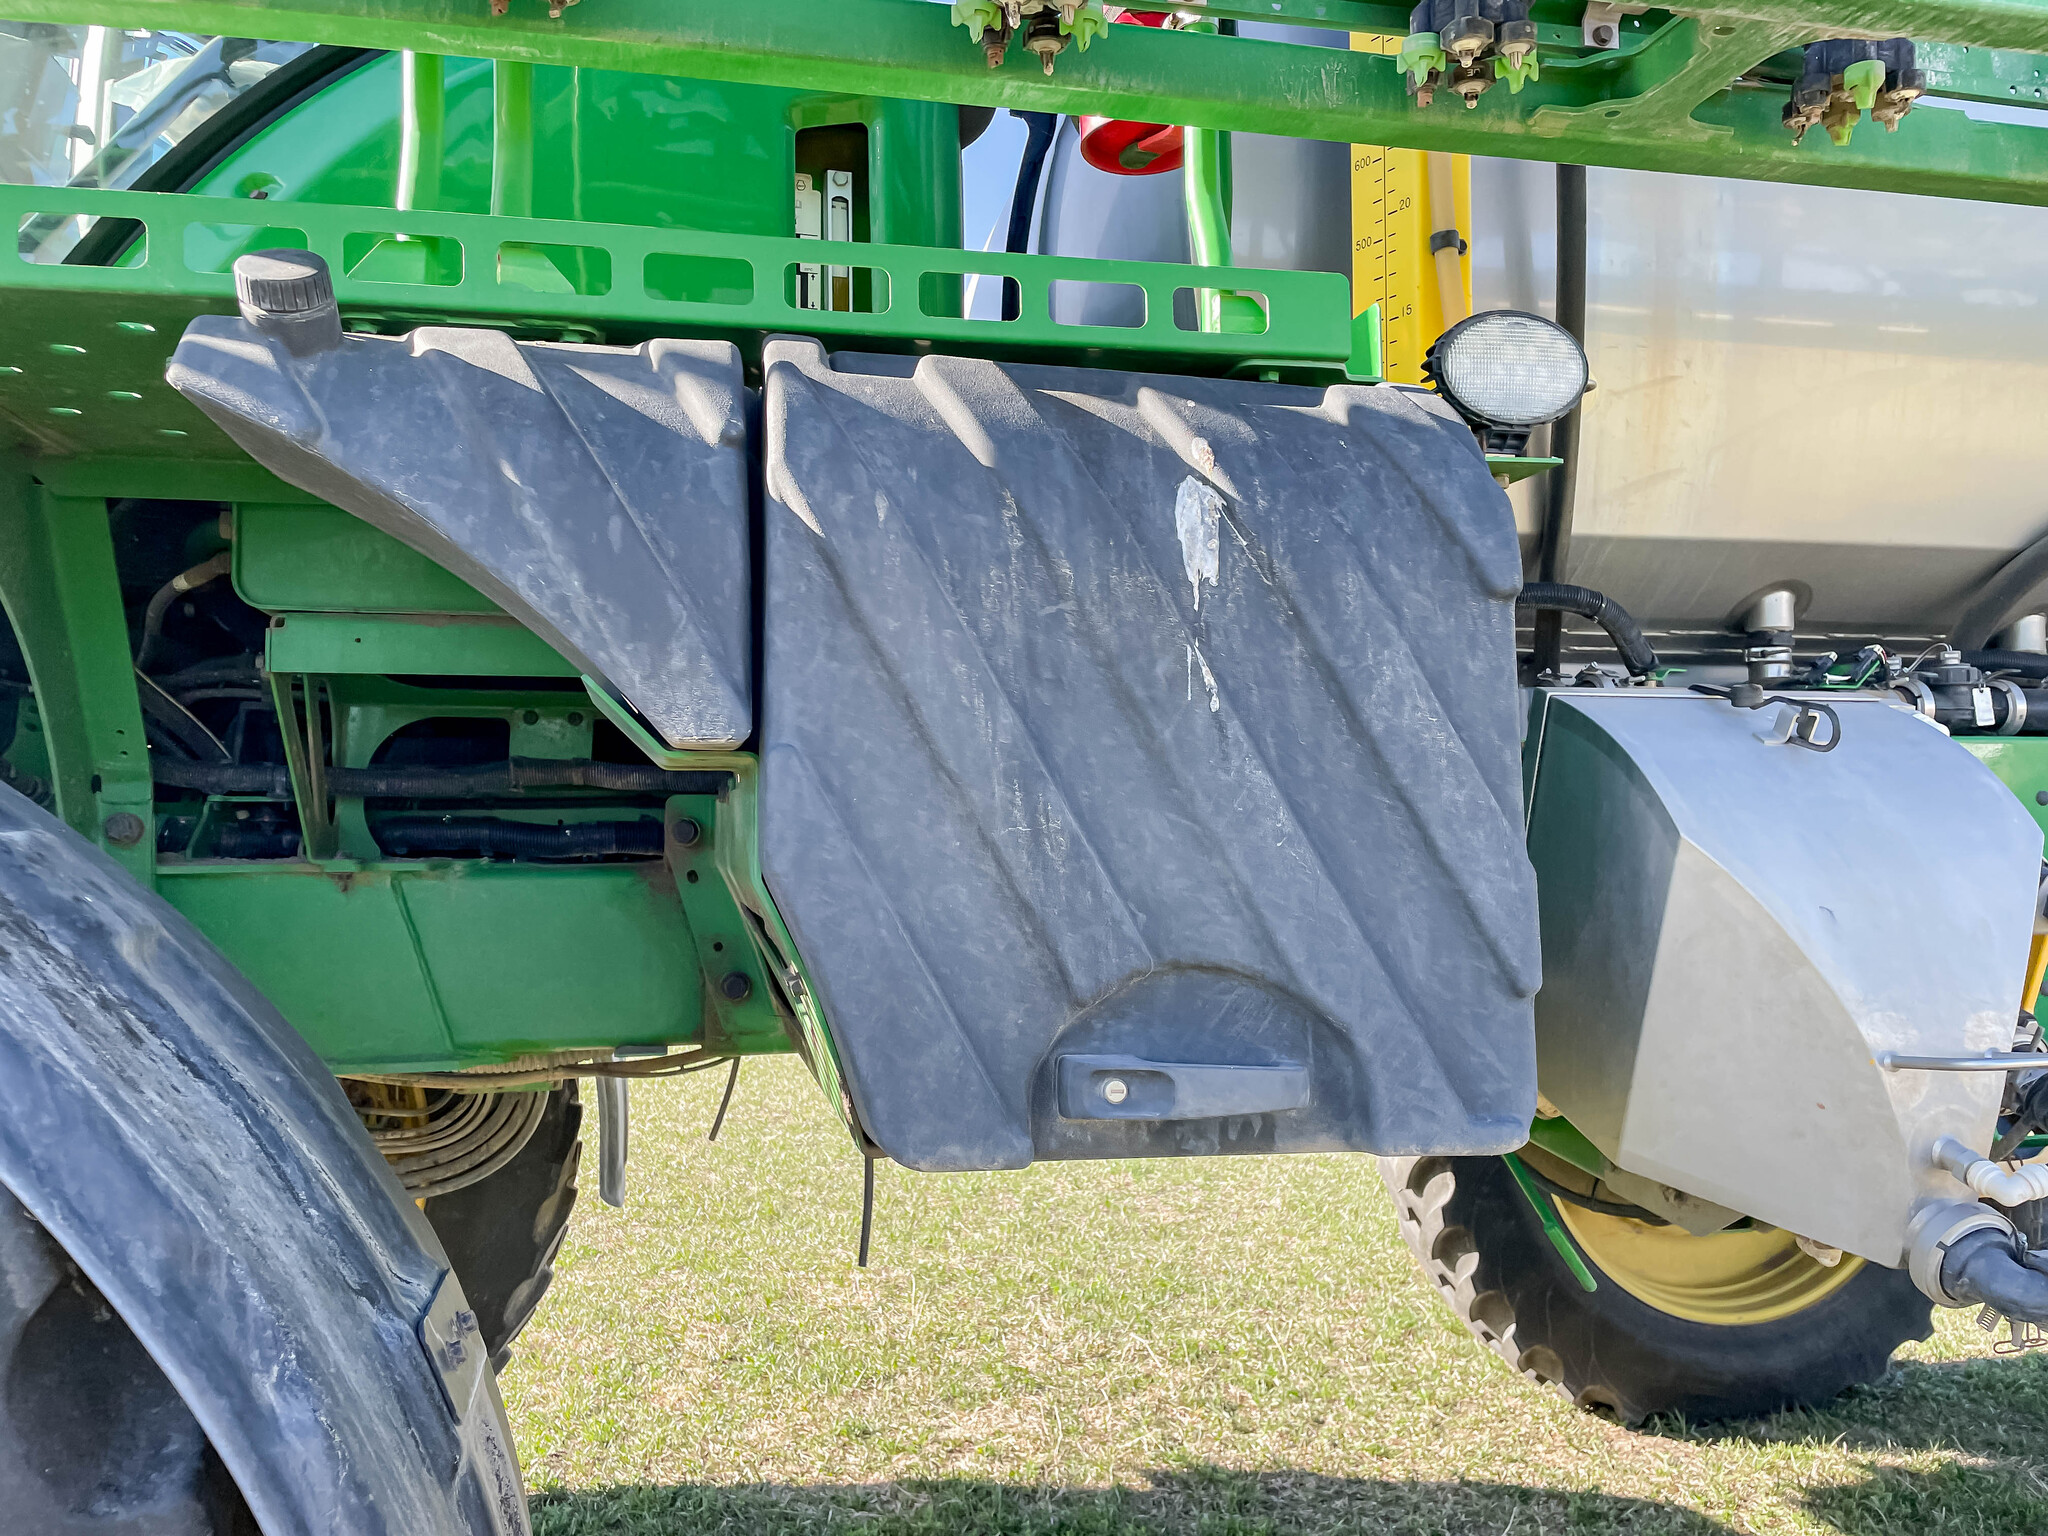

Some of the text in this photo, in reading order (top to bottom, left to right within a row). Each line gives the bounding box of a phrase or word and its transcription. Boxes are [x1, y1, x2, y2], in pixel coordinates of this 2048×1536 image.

[1354, 156, 1371, 172] 600
[1399, 197, 1411, 211] 20
[1355, 236, 1372, 252] 500
[1401, 303, 1412, 317] 15
